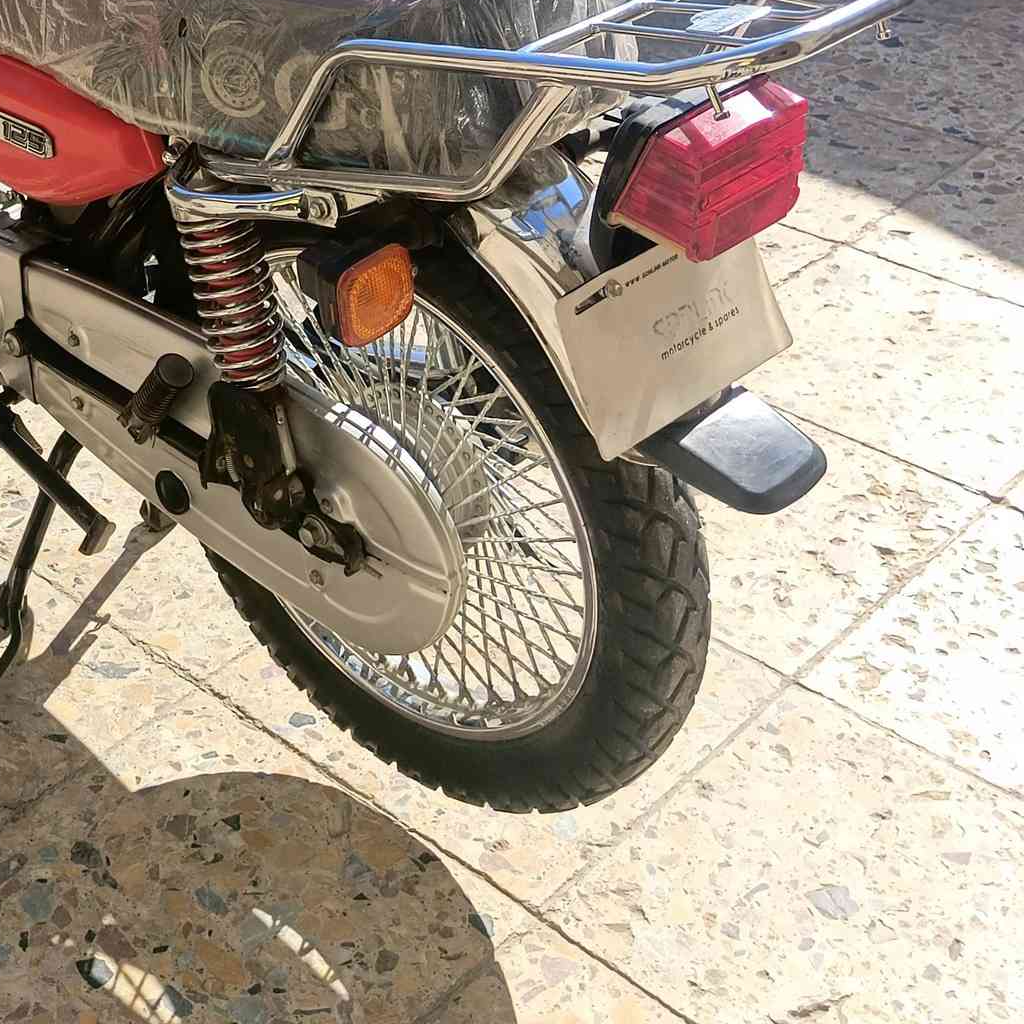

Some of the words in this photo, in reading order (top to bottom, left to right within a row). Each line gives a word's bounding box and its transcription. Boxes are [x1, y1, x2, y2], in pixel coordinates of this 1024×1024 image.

[660, 326, 707, 361] motorcycle
[708, 321, 715, 331] &
[714, 306, 740, 328] spares
